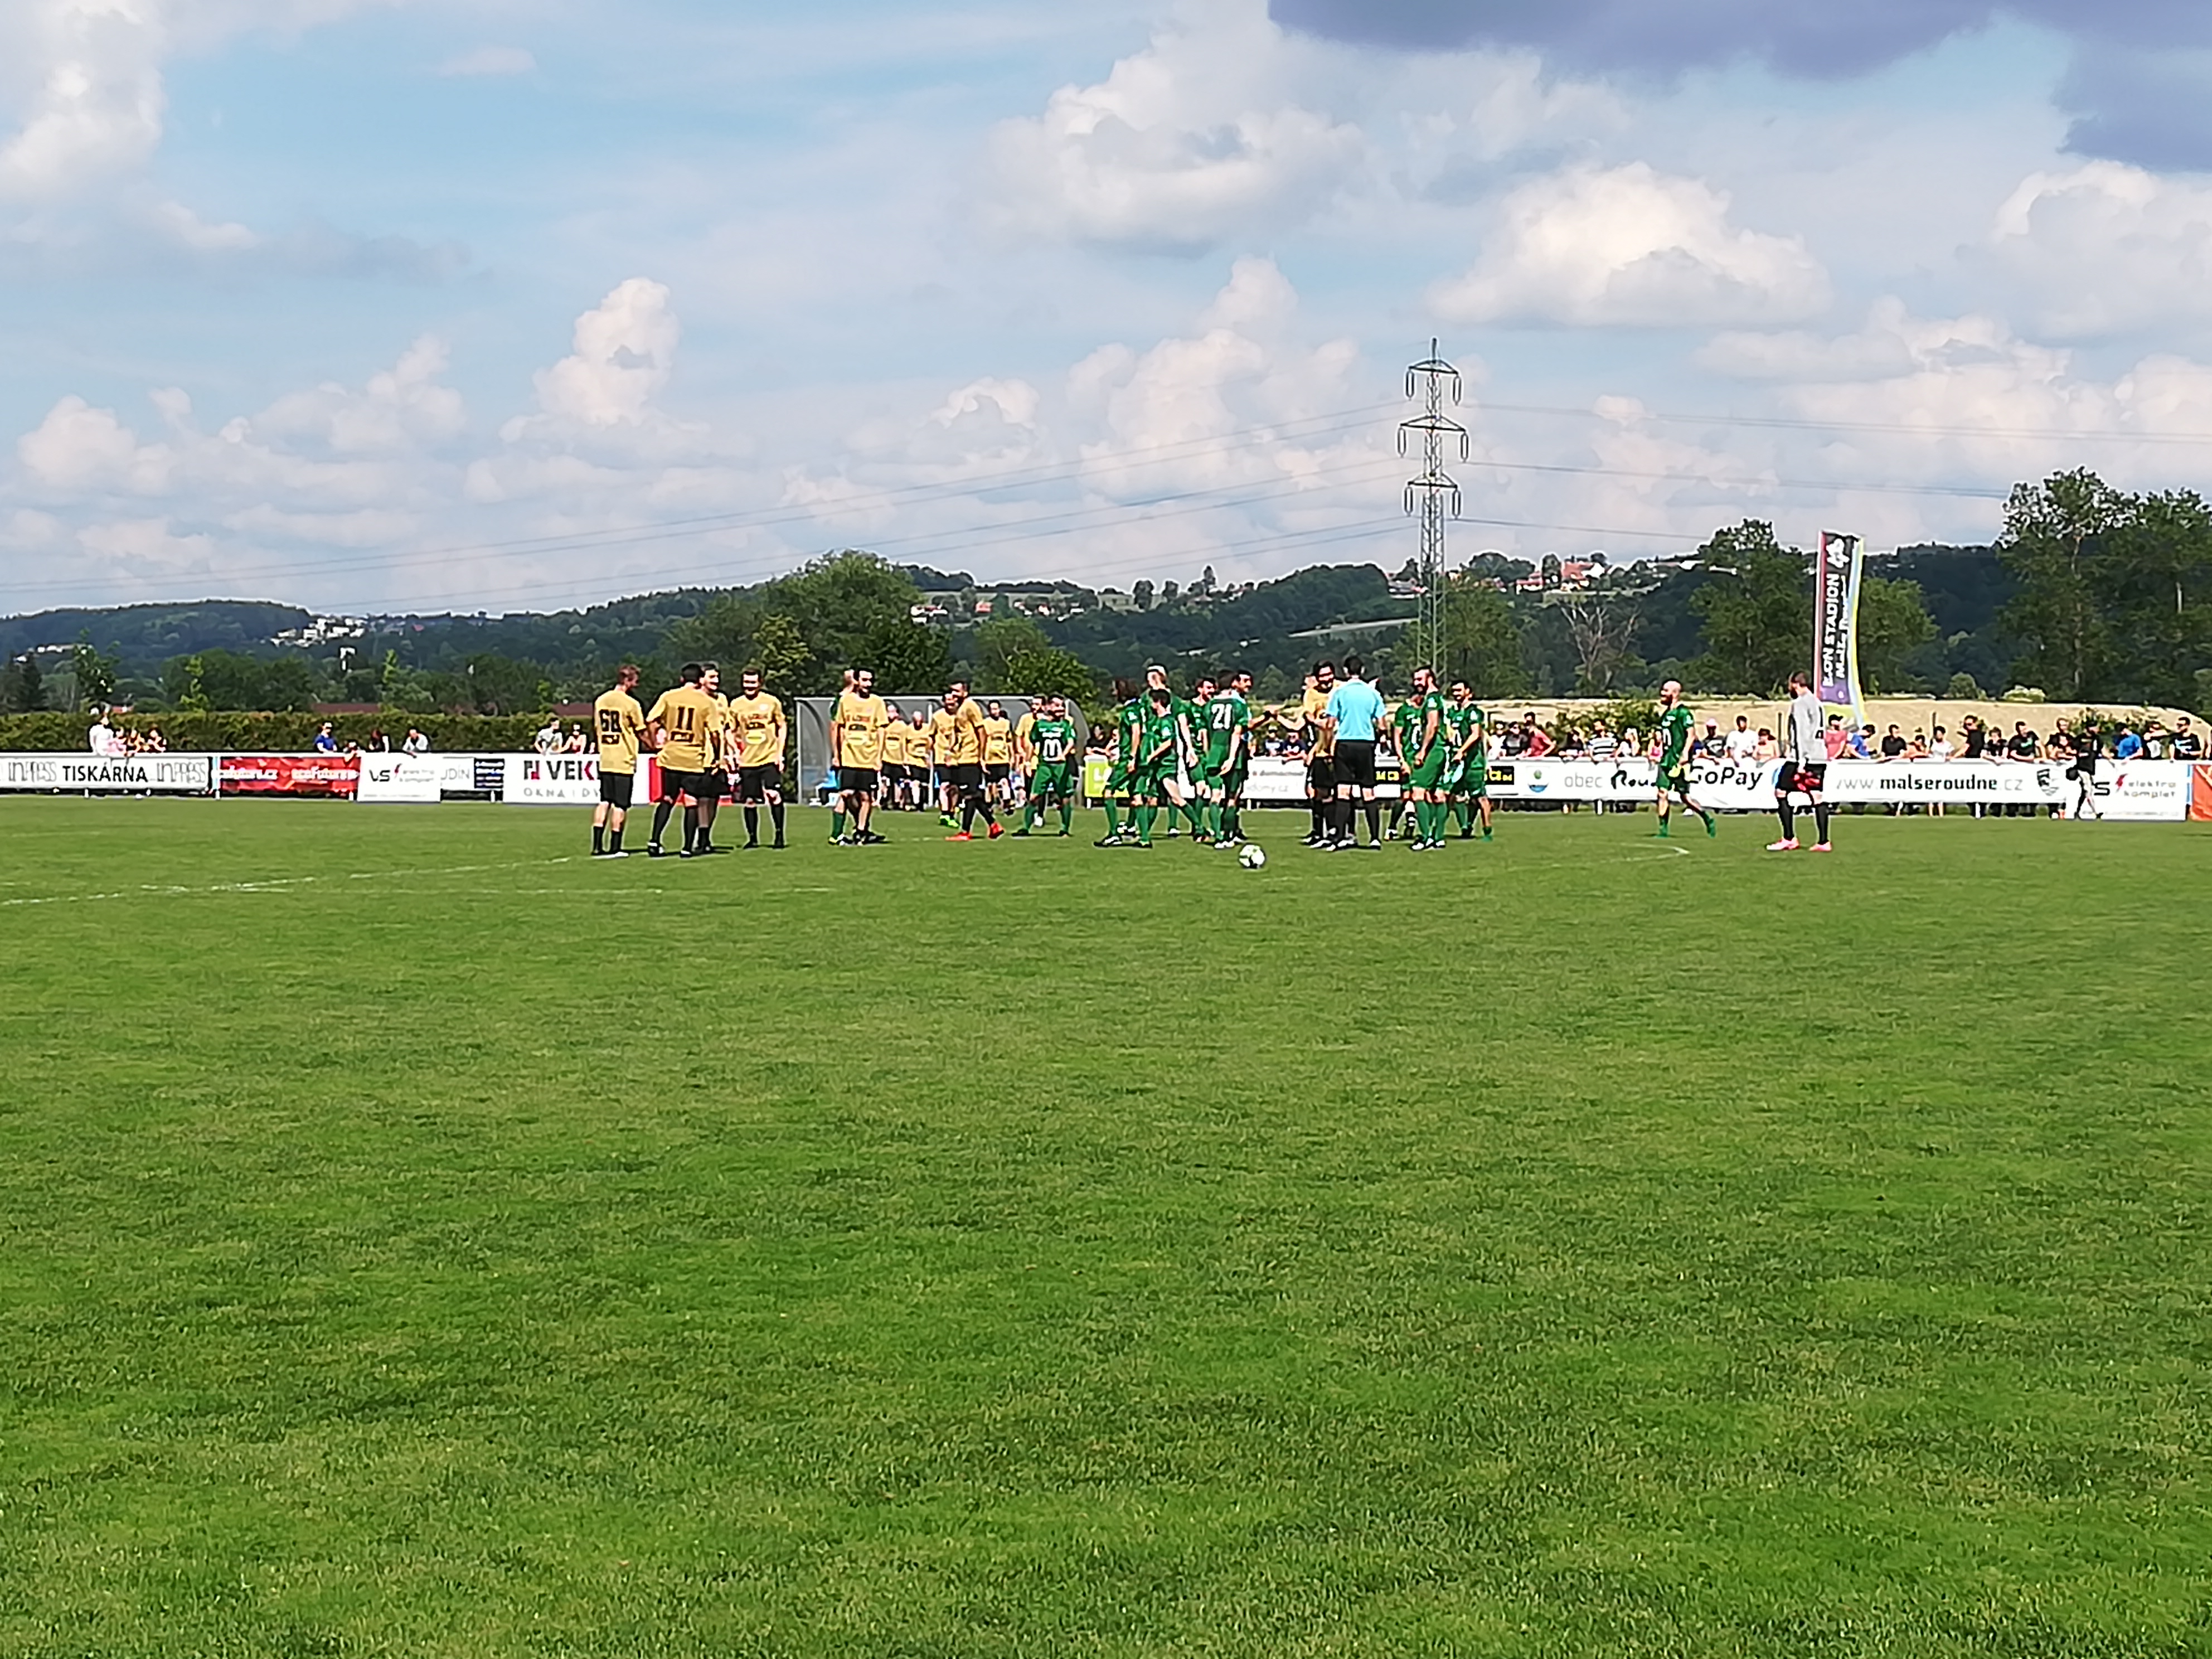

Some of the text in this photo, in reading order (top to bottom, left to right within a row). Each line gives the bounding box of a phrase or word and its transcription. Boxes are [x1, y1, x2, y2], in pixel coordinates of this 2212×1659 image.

[1825, 573, 1840, 645] STADION
[675, 706, 695, 731] 11
[1211, 703, 1233, 730] 21
[62, 761, 148, 783] TISKÁRNA
[1564, 772, 1603, 788] obec
[1689, 766, 1763, 790] GoPay
[523, 787, 566, 798] OKNA
[2123, 789, 2176, 799] komplet
[2127, 780, 2176, 788] elektro
